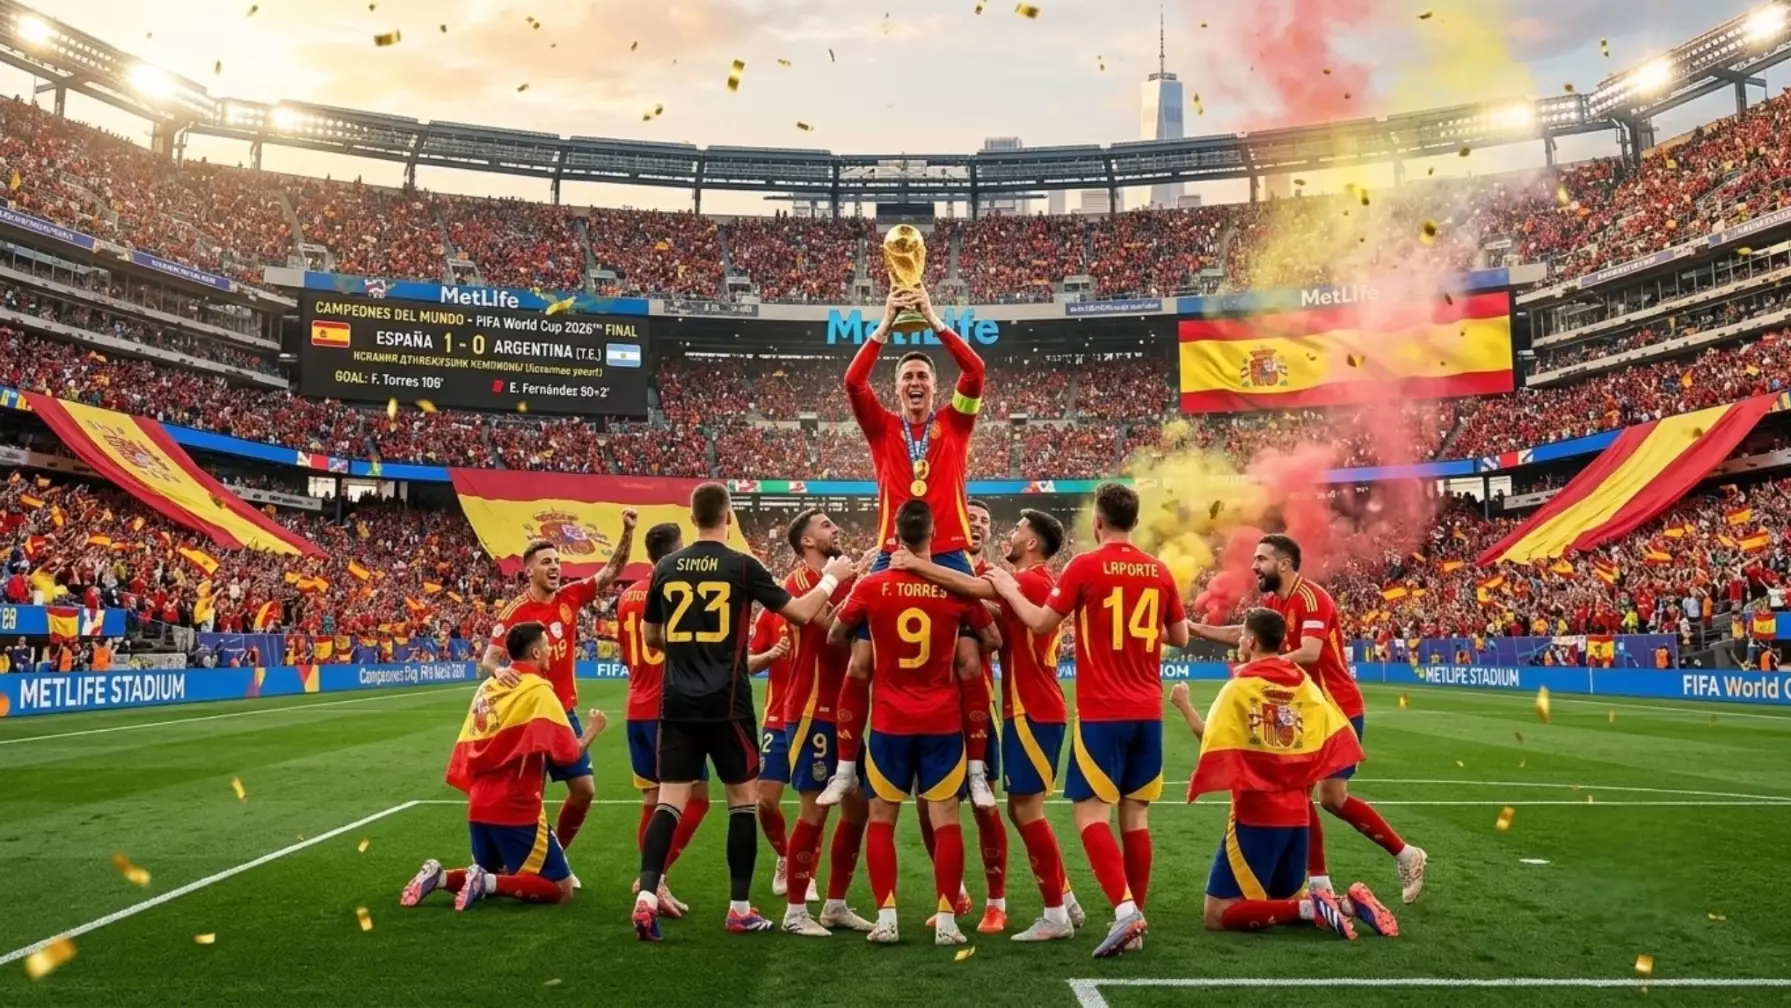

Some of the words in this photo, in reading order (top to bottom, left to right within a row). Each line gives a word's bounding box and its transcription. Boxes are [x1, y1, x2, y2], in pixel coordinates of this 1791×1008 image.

[1301, 284, 1380, 307] MetLife
[315, 301, 391, 320] CAMPEONES
[394, 309, 417, 322] DEL
[419, 310, 464, 325] MUNDO
[540, 319, 563, 335] Cup
[605, 324, 638, 337] FINAL
[376, 330, 433, 349] ESPAÑA
[444, 332, 452, 353] 1
[472, 334, 485, 355] 0
[494, 339, 573, 359] ARGENTINA
[335, 369, 368, 384] GOAL:
[371, 372, 380, 385] F.
[382, 374, 419, 388] Torres
[509, 381, 519, 394] E.
[881, 582, 892, 597] F.
[896, 582, 948, 599] TORRES
[663, 581, 731, 642] 23
[1103, 586, 1160, 653] 14
[553, 638, 568, 661] 19
[897, 607, 931, 668] 9
[597, 663, 631, 677] FIFA
[1470, 667, 1520, 687] STADIUM
[19, 675, 106, 710] METLIFE
[110, 673, 186, 704] STADIUM
[1682, 674, 1721, 697] FIFA
[1723, 676, 1780, 699] World
[762, 732, 774, 753] 2
[812, 732, 827, 758] 9
